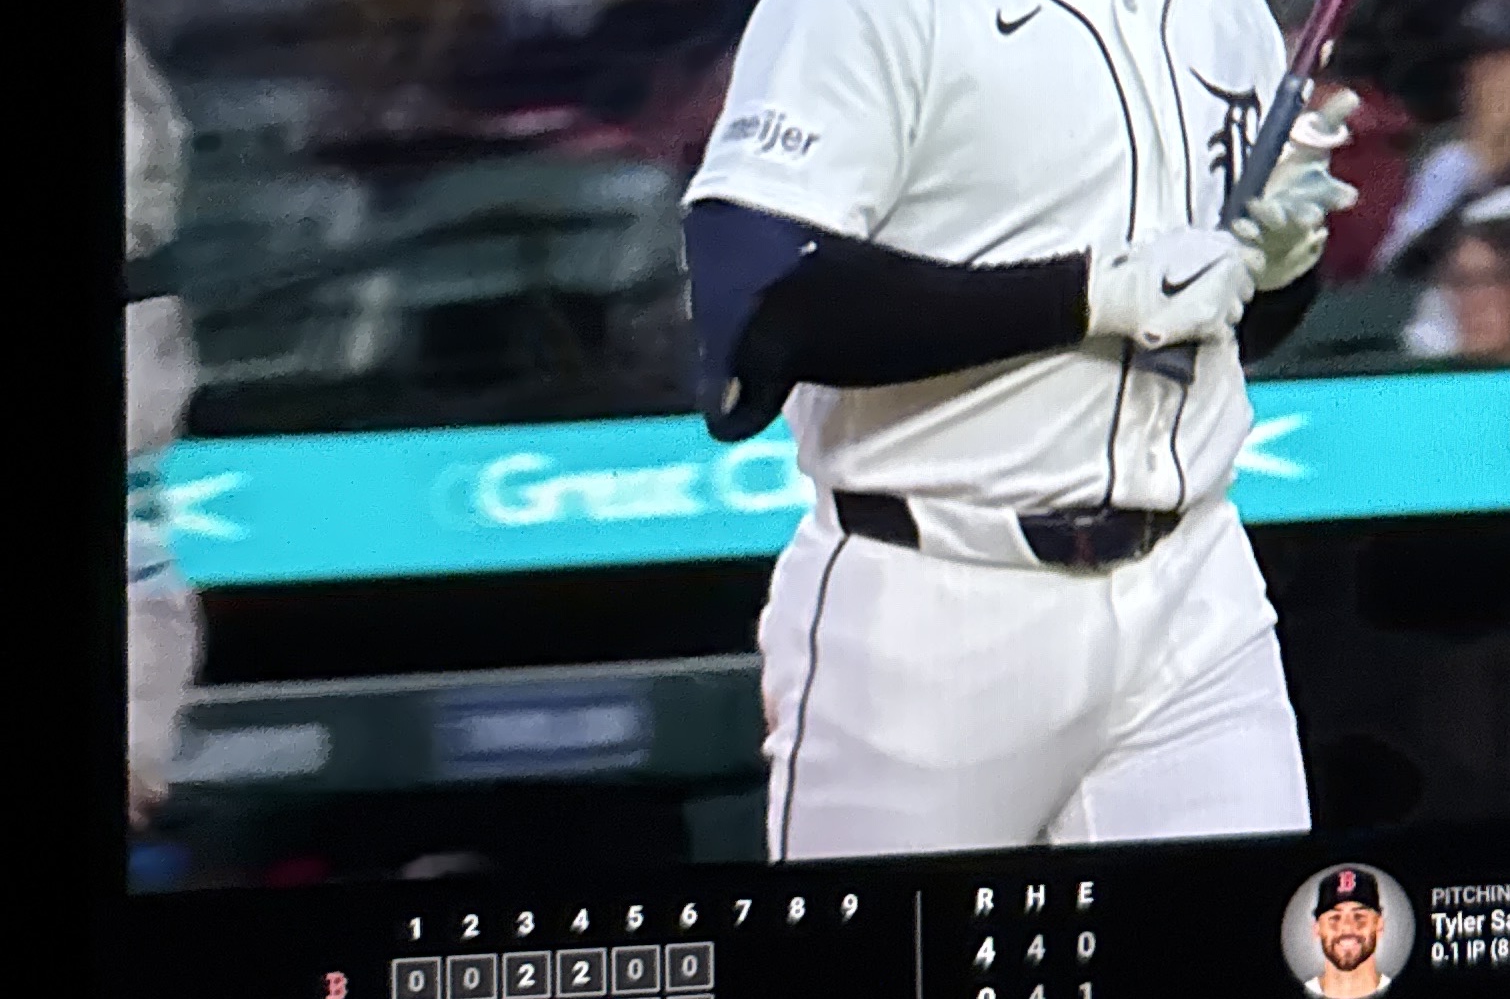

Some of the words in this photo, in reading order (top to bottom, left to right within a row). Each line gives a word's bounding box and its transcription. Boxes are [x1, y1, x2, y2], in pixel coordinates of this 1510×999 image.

[976, 888, 994, 913] R
[1027, 885, 1045, 908] H
[1078, 882, 1094, 905] E
[410, 918, 420, 939] 1
[464, 914, 479, 937] 2
[518, 912, 534, 935] 3
[573, 909, 589, 930] 4
[628, 905, 643, 929] 5
[681, 903, 698, 926] 6
[736, 900, 752, 923] 7
[789, 897, 805, 920] 8
[842, 894, 858, 918] 9
[1431, 911, 1484, 942] Tyler
[976, 937, 995, 966] 4
[1028, 935, 1045, 960] 4
[1078, 932, 1095, 957] 0
[1432, 936, 1458, 962] 0.1
[1467, 940, 1485, 960] IP
